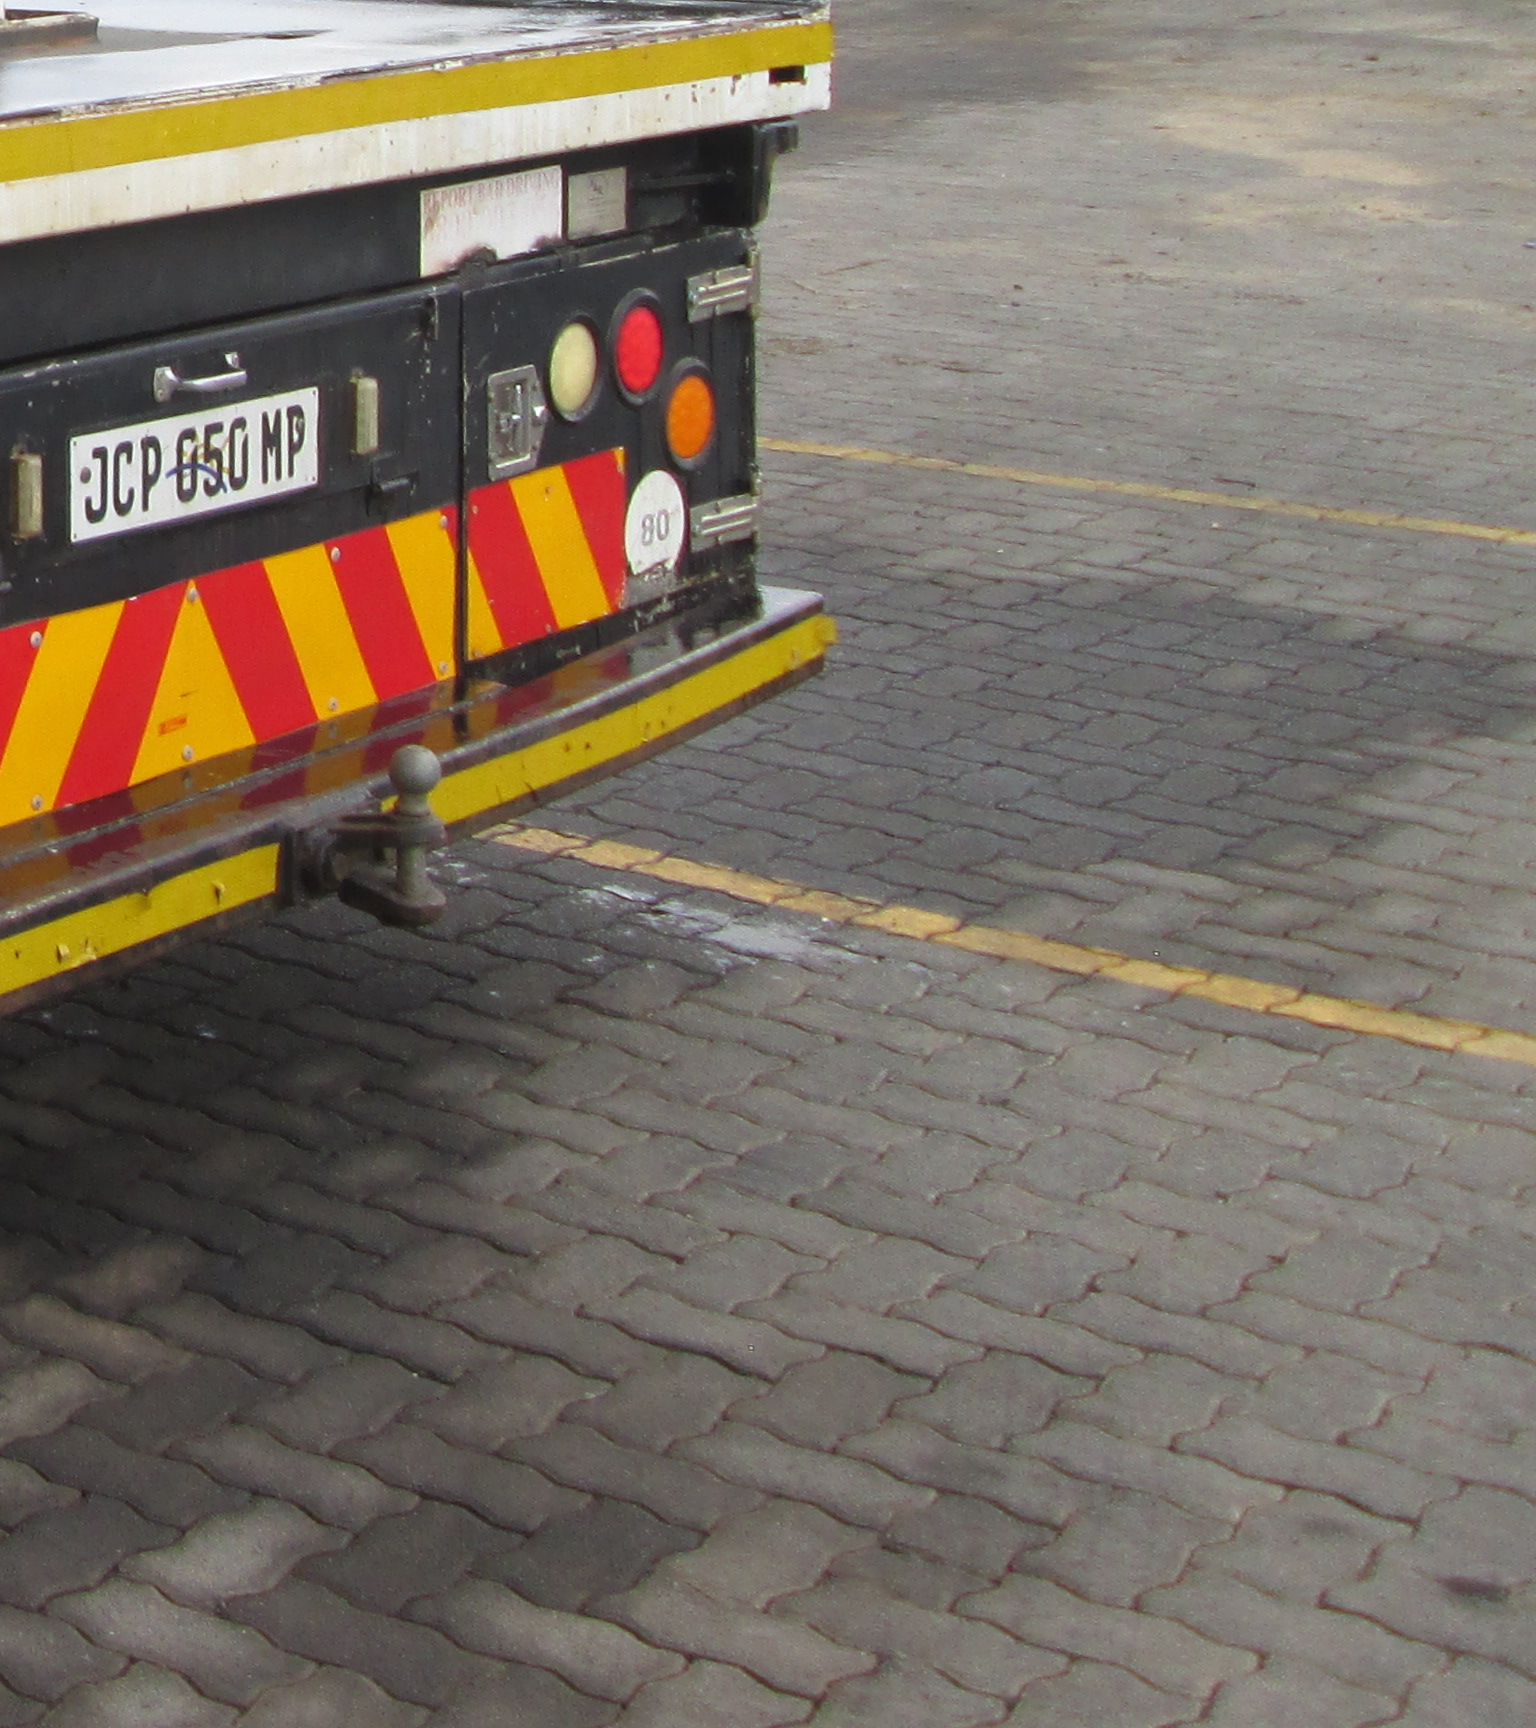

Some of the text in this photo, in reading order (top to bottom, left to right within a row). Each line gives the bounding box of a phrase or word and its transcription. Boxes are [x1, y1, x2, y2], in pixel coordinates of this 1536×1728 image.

[84, 434, 163, 524] JCP
[261, 403, 306, 485] MP
[641, 508, 670, 547] 80
